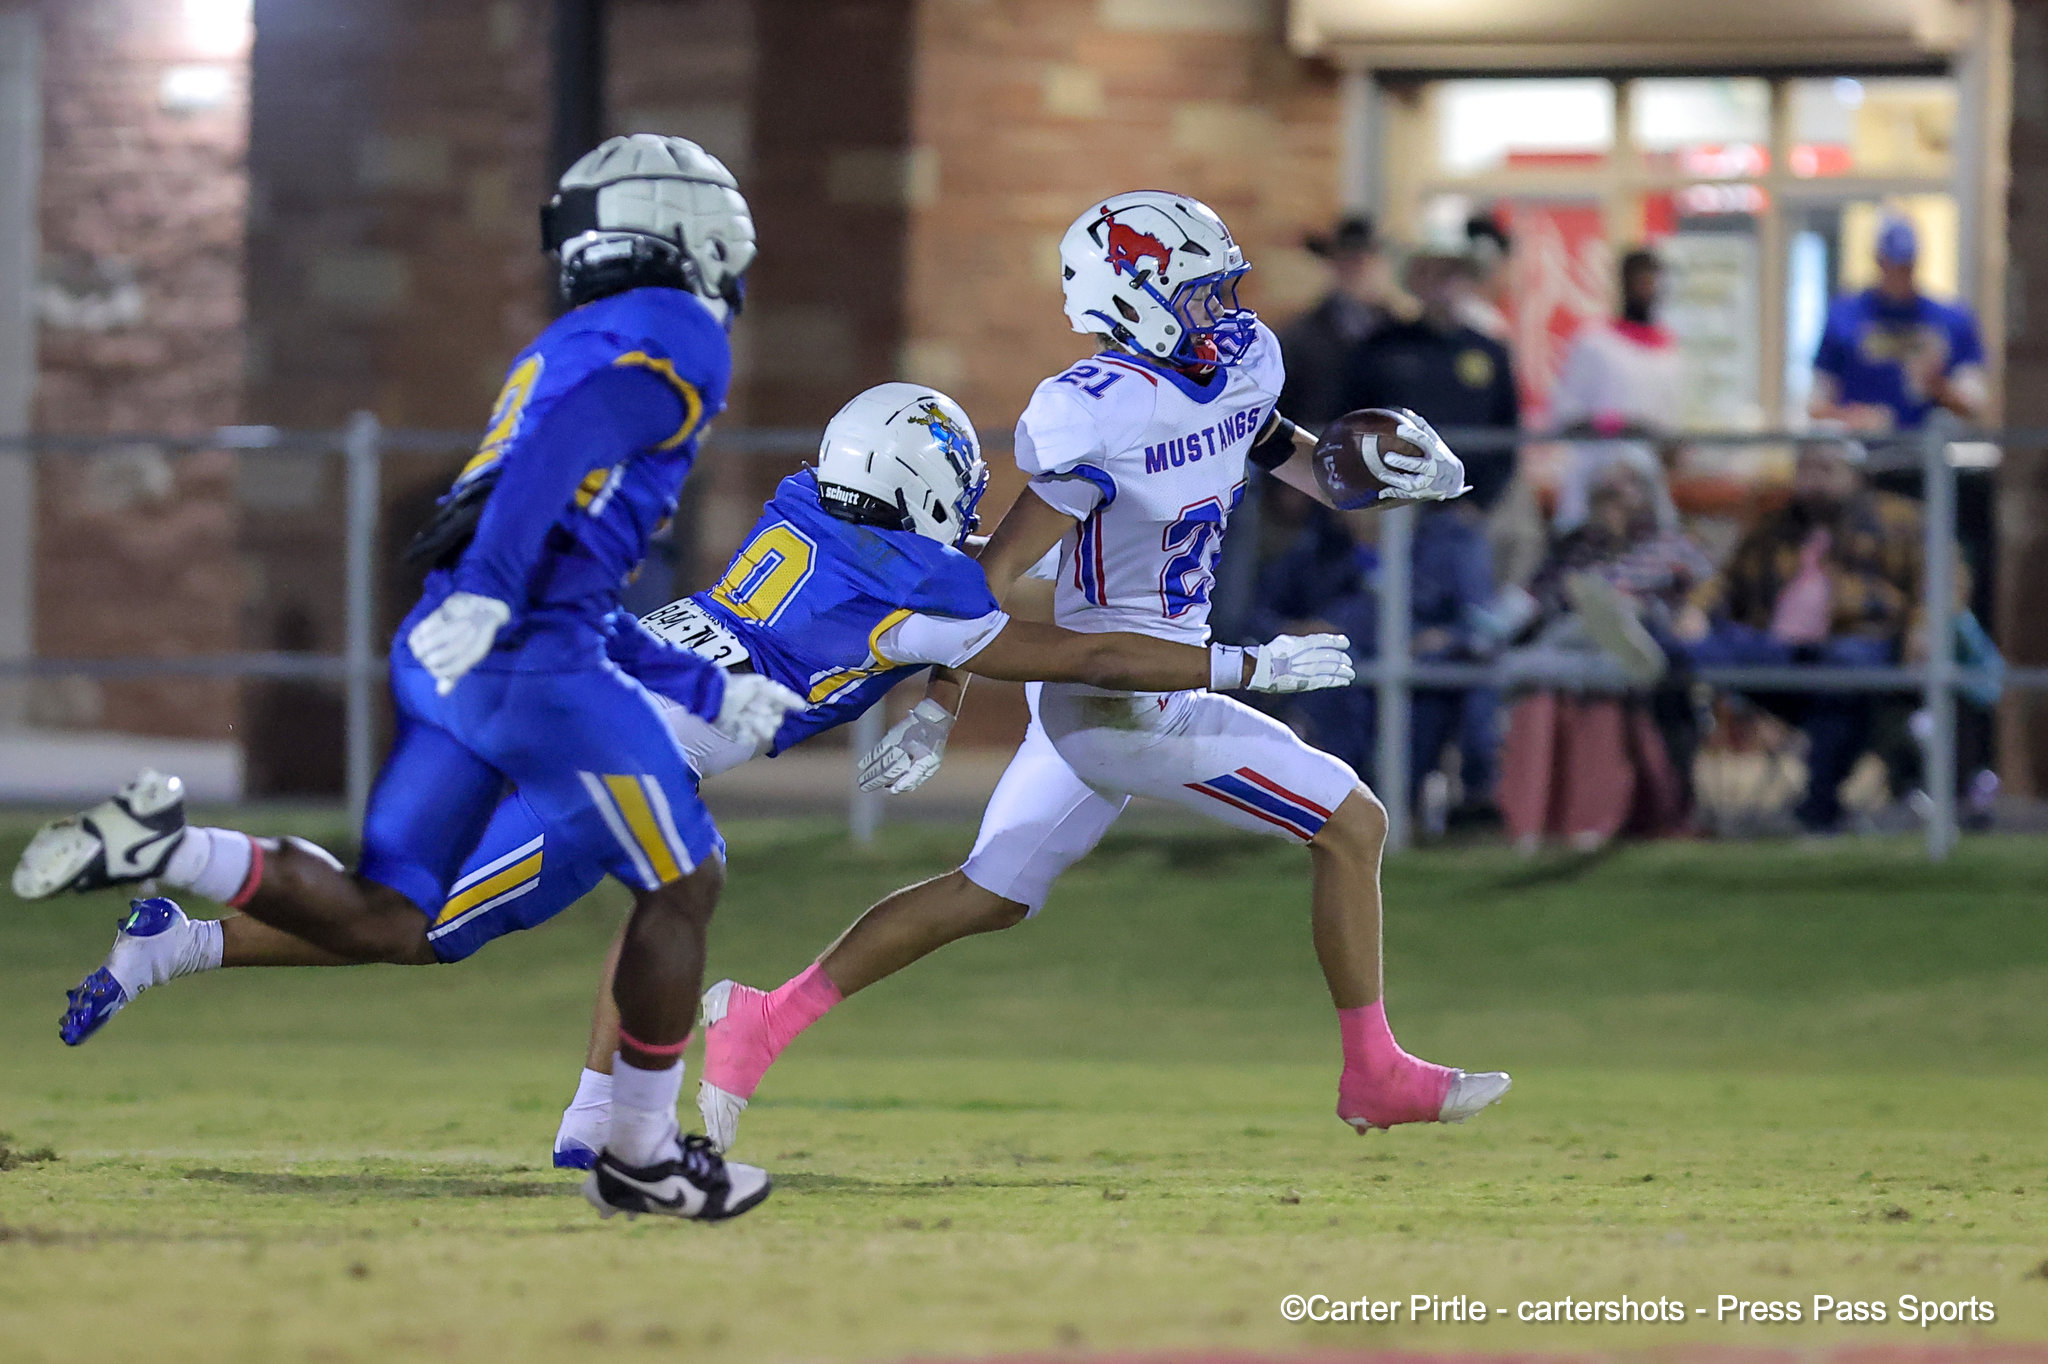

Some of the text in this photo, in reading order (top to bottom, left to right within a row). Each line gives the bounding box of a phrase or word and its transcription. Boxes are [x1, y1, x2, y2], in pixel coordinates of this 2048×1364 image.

[1054, 365, 1125, 400] 21
[1144, 407, 1261, 475] MUSTANGS
[707, 519, 818, 628] 0
